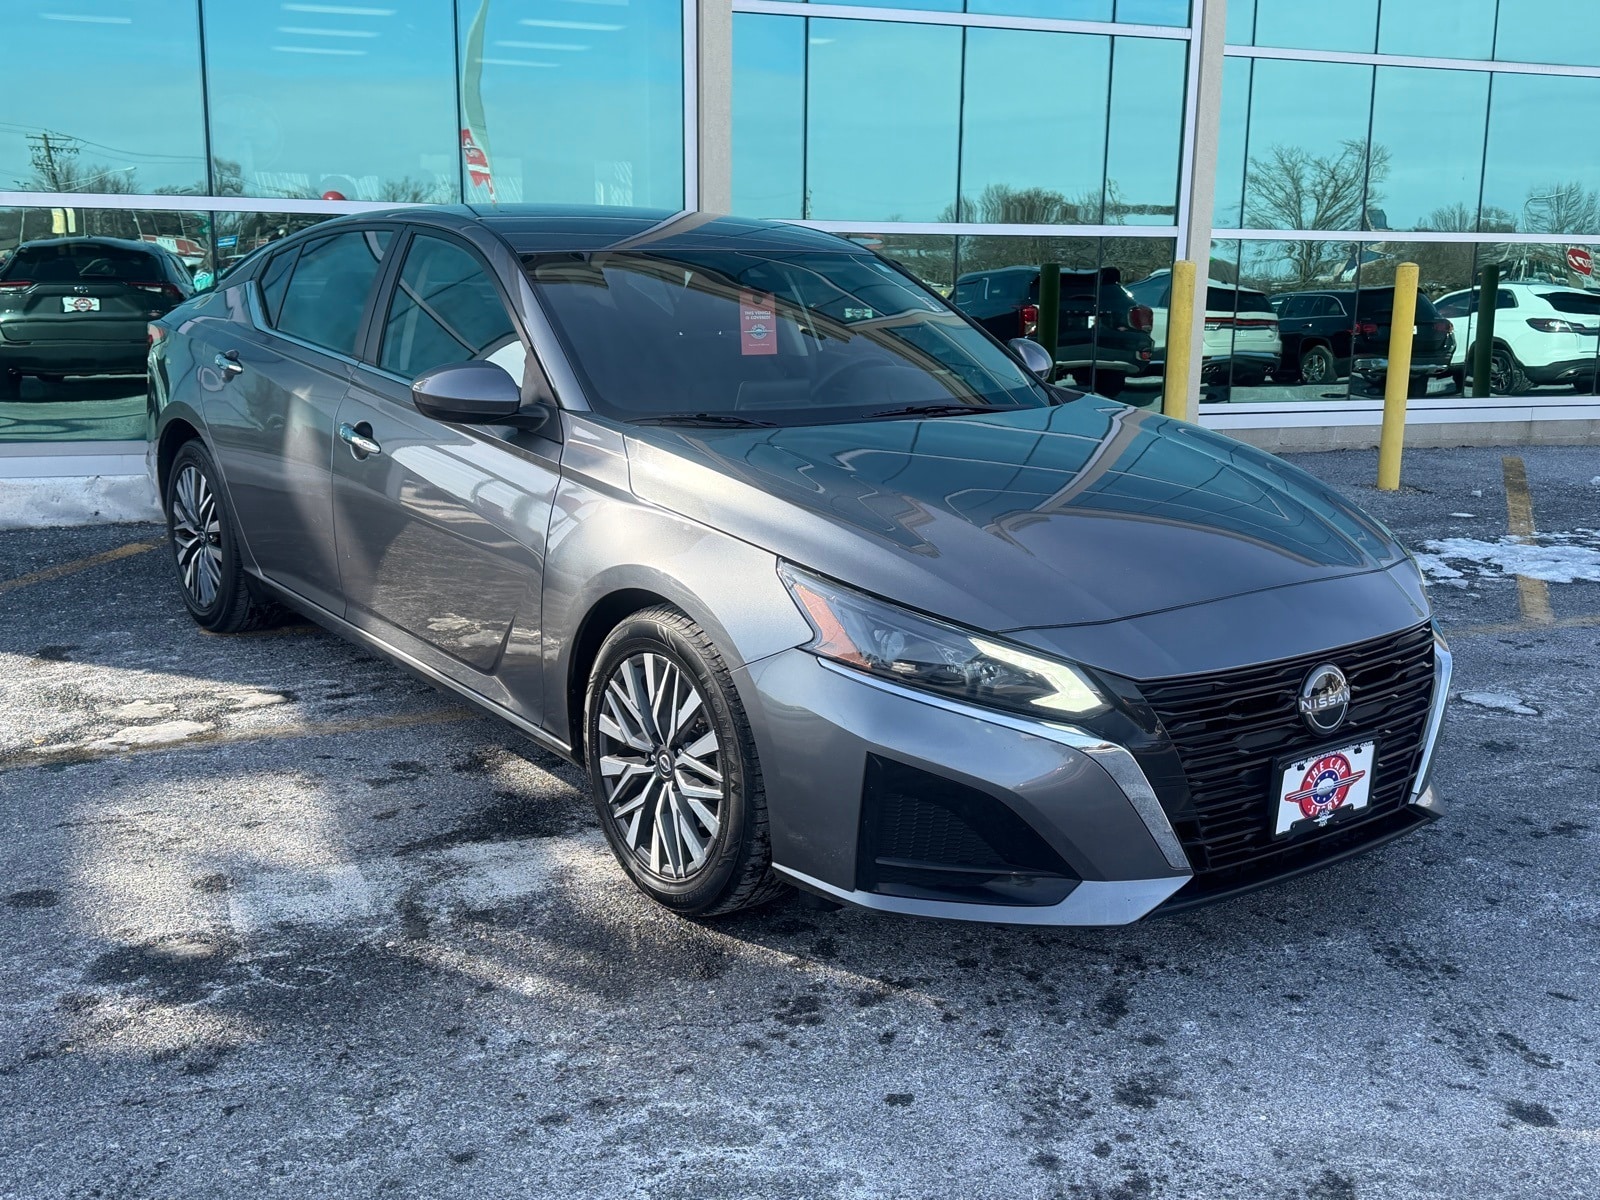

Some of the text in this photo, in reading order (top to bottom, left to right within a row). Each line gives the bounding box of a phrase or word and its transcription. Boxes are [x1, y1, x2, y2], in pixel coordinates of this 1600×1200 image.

[1301, 686, 1350, 711] NISSAN
[1306, 757, 1346, 784] THE CAR
